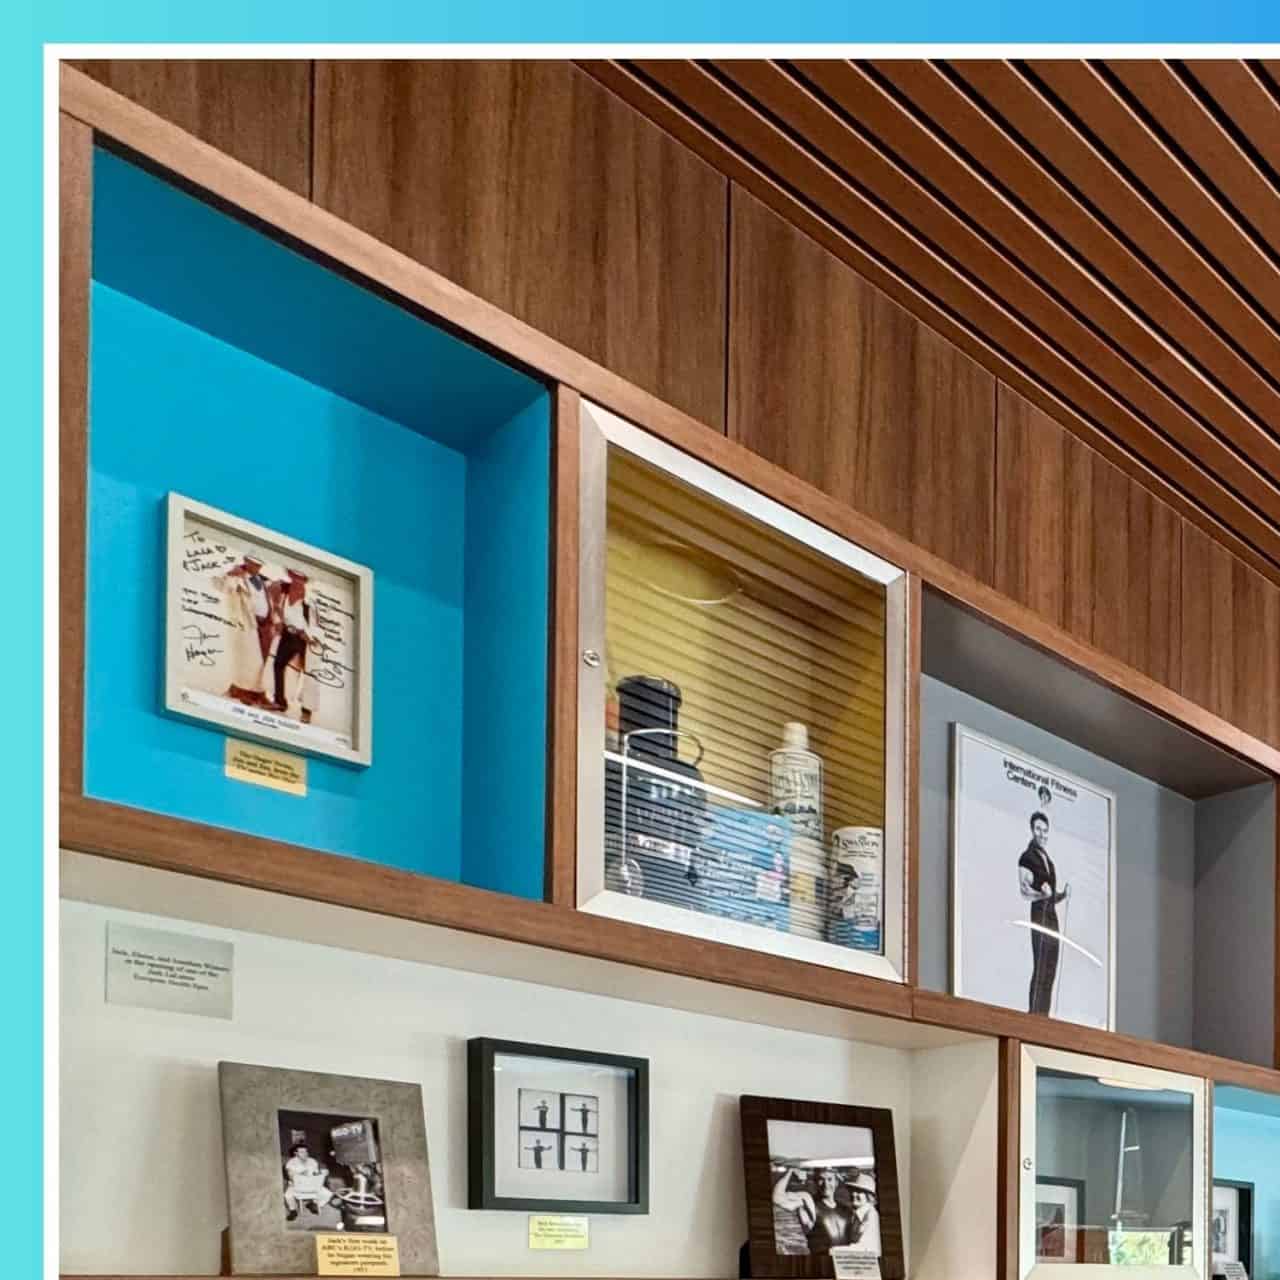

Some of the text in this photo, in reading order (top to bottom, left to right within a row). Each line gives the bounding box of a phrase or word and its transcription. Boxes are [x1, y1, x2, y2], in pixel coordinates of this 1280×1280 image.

[1003, 757, 1050, 786] International
[1051, 778, 1078, 798] Fitness
[1006, 769, 1037, 791] Centers
